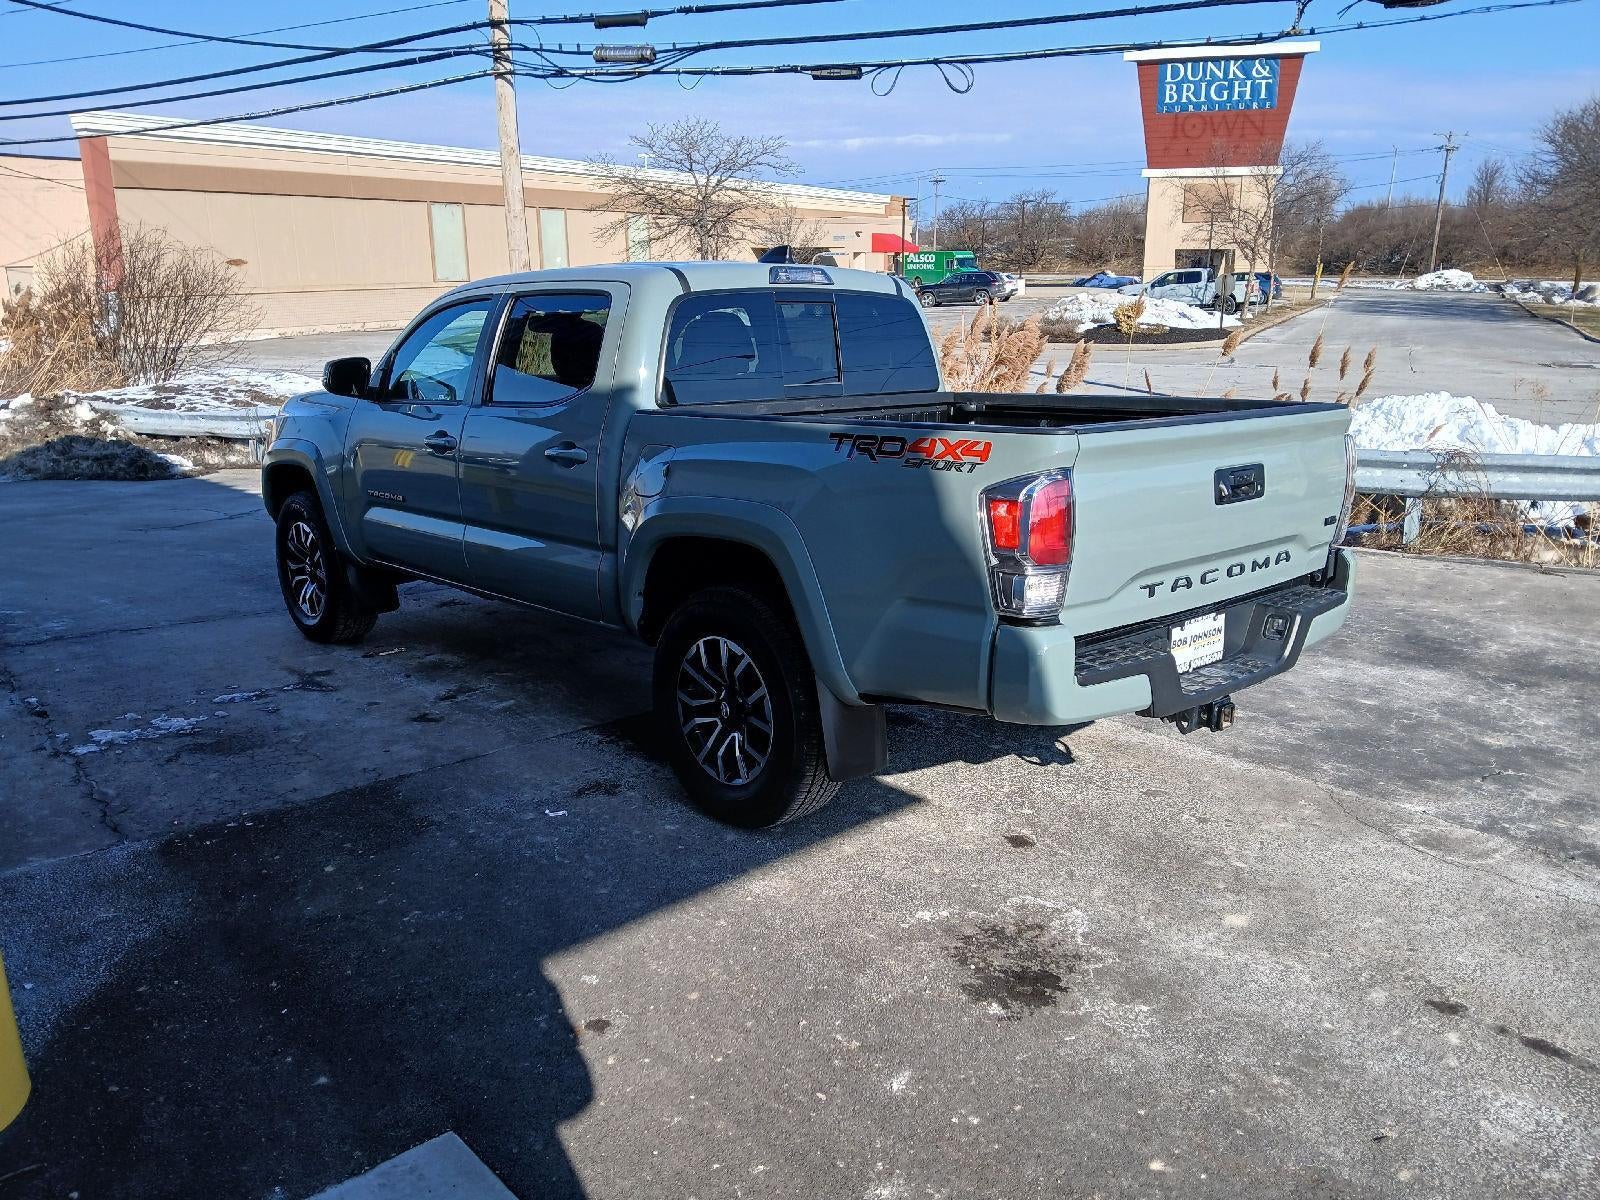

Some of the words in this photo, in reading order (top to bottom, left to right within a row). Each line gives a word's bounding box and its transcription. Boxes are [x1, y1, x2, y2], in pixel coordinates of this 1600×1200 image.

[1165, 59, 1246, 83] DUNK
[1252, 58, 1272, 77] &
[1164, 79, 1273, 104] BRIGHT
[1163, 102, 1271, 113] FURNITURE
[907, 253, 936, 263] ALSCO
[828, 432, 908, 464] TRD
[902, 457, 983, 474] SPORT
[367, 489, 403, 501] TACOMA
[1139, 549, 1292, 599] TACOMA
[1171, 636, 1188, 650] BOB
[1189, 626, 1223, 648] JOHNSON
